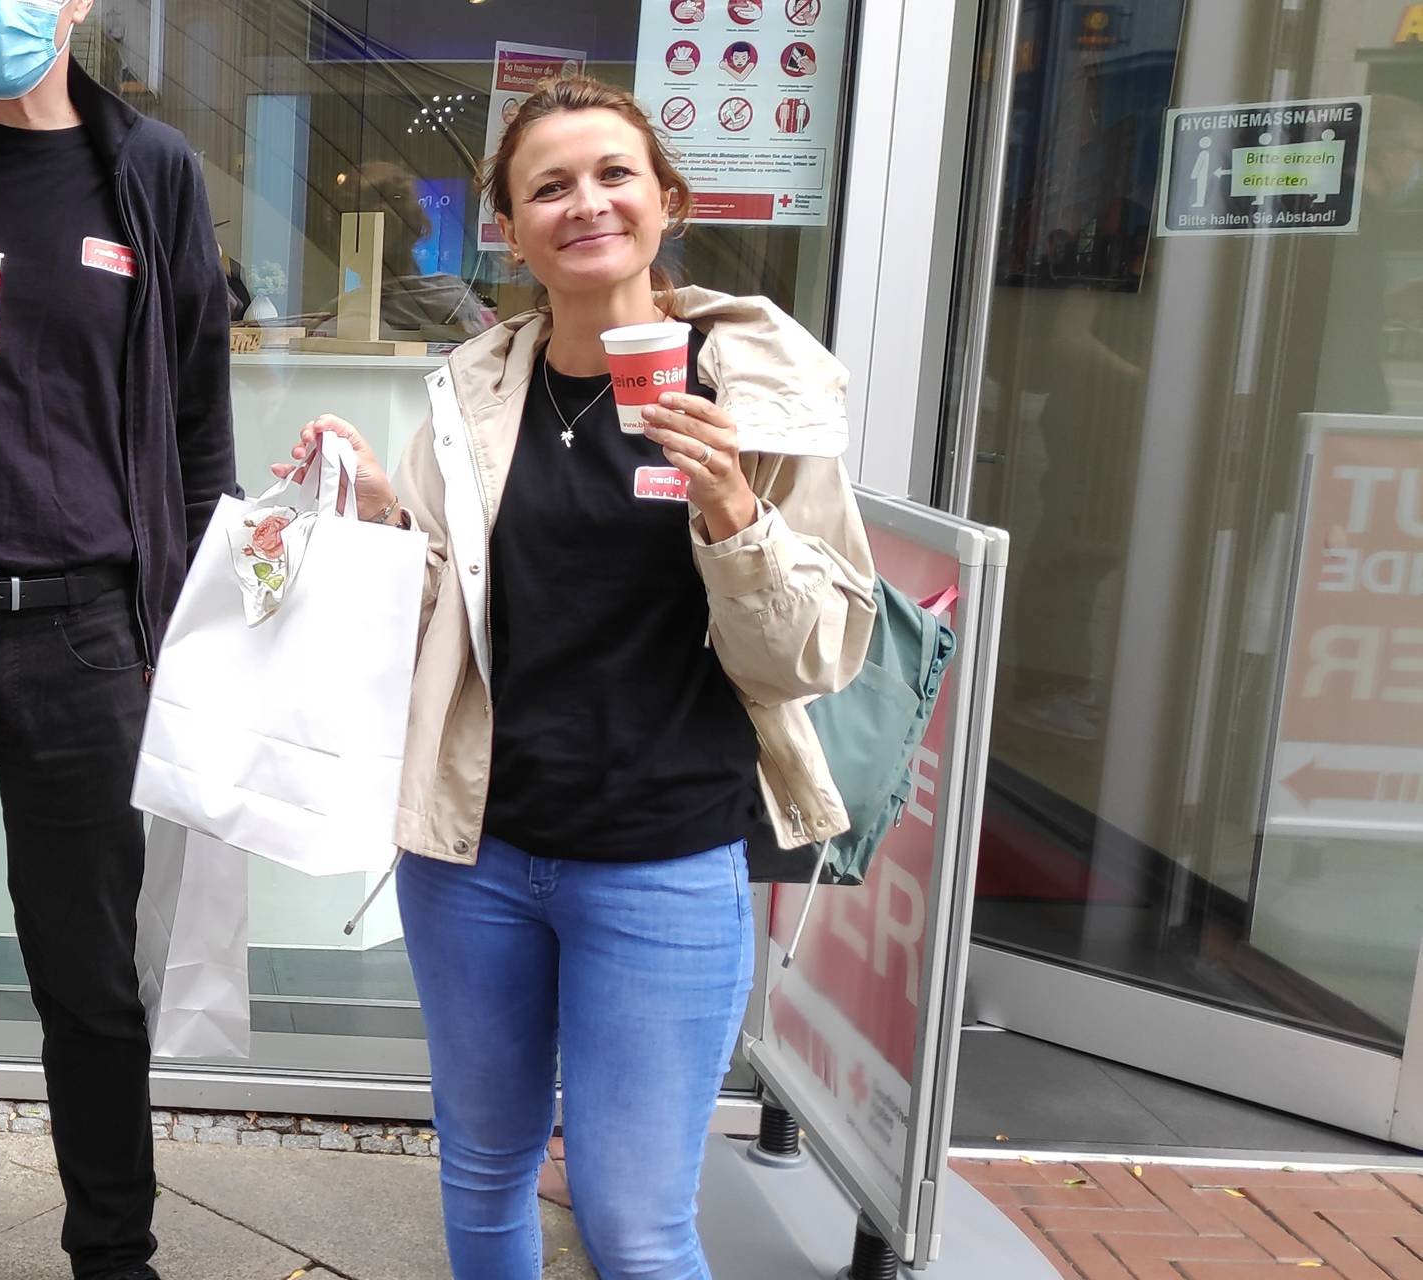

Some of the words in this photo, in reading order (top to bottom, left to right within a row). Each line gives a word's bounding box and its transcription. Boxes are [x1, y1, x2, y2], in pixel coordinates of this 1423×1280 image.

[1181, 108, 1354, 132] HYGIENEMASSNAHME
[1246, 152, 1280, 164] Bitte
[1284, 152, 1335, 164] einzeln
[1243, 175, 1308, 187] eintreten
[1178, 214, 1206, 226] Bitte
[1210, 212, 1248, 225] halten
[1252, 212, 1272, 224] Sie
[1276, 210, 1336, 224] Abstand!
[614, 376, 646, 388] eine
[650, 476, 681, 486] radio
